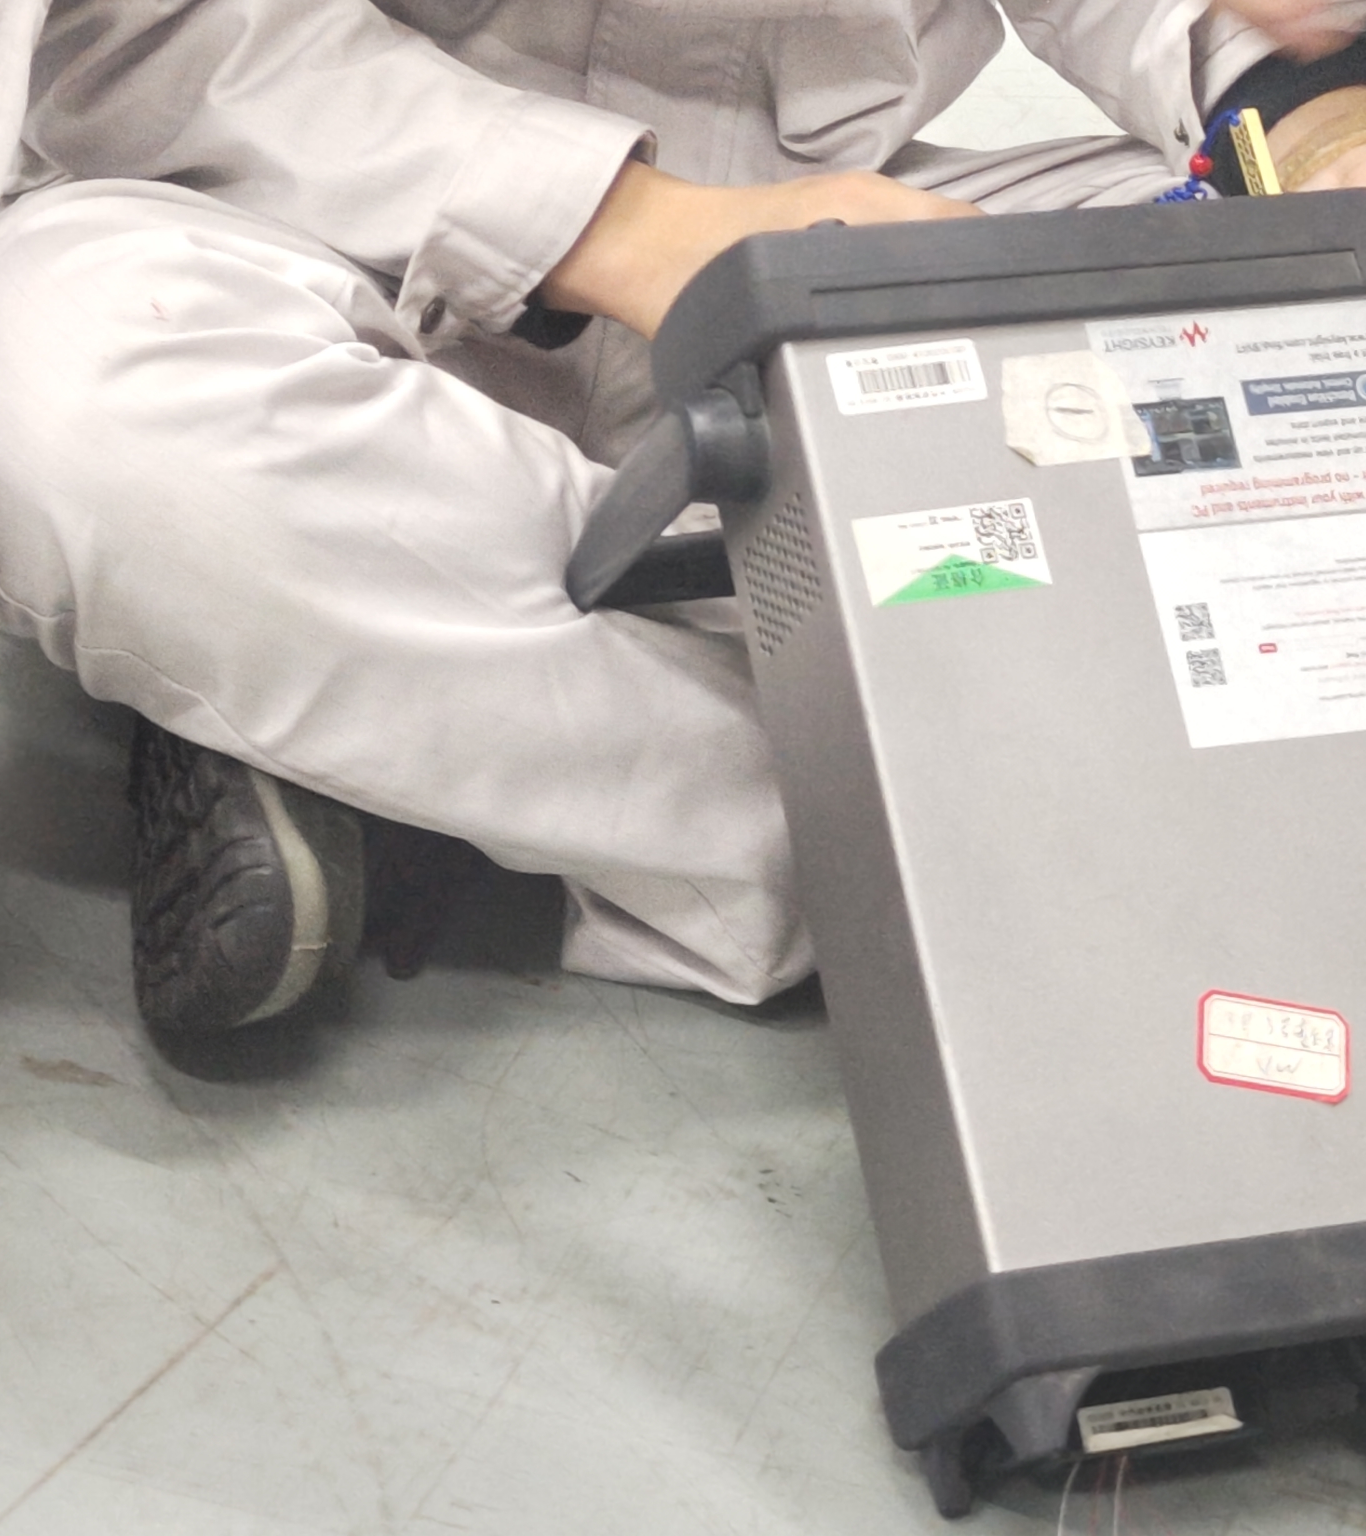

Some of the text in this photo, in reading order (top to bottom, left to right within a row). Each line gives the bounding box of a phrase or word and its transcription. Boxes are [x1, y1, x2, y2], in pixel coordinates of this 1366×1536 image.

[1102, 335, 1176, 352] KEYSIGHT
[1251, 469, 1332, 490] programming
[1334, 471, 1350, 481] no
[1198, 478, 1250, 496] required
[1235, 495, 1309, 513] instruments
[1309, 490, 1337, 505] your
[1338, 489, 1366, 504] with
[1189, 503, 1209, 517] PC
[1210, 501, 1235, 515] and
